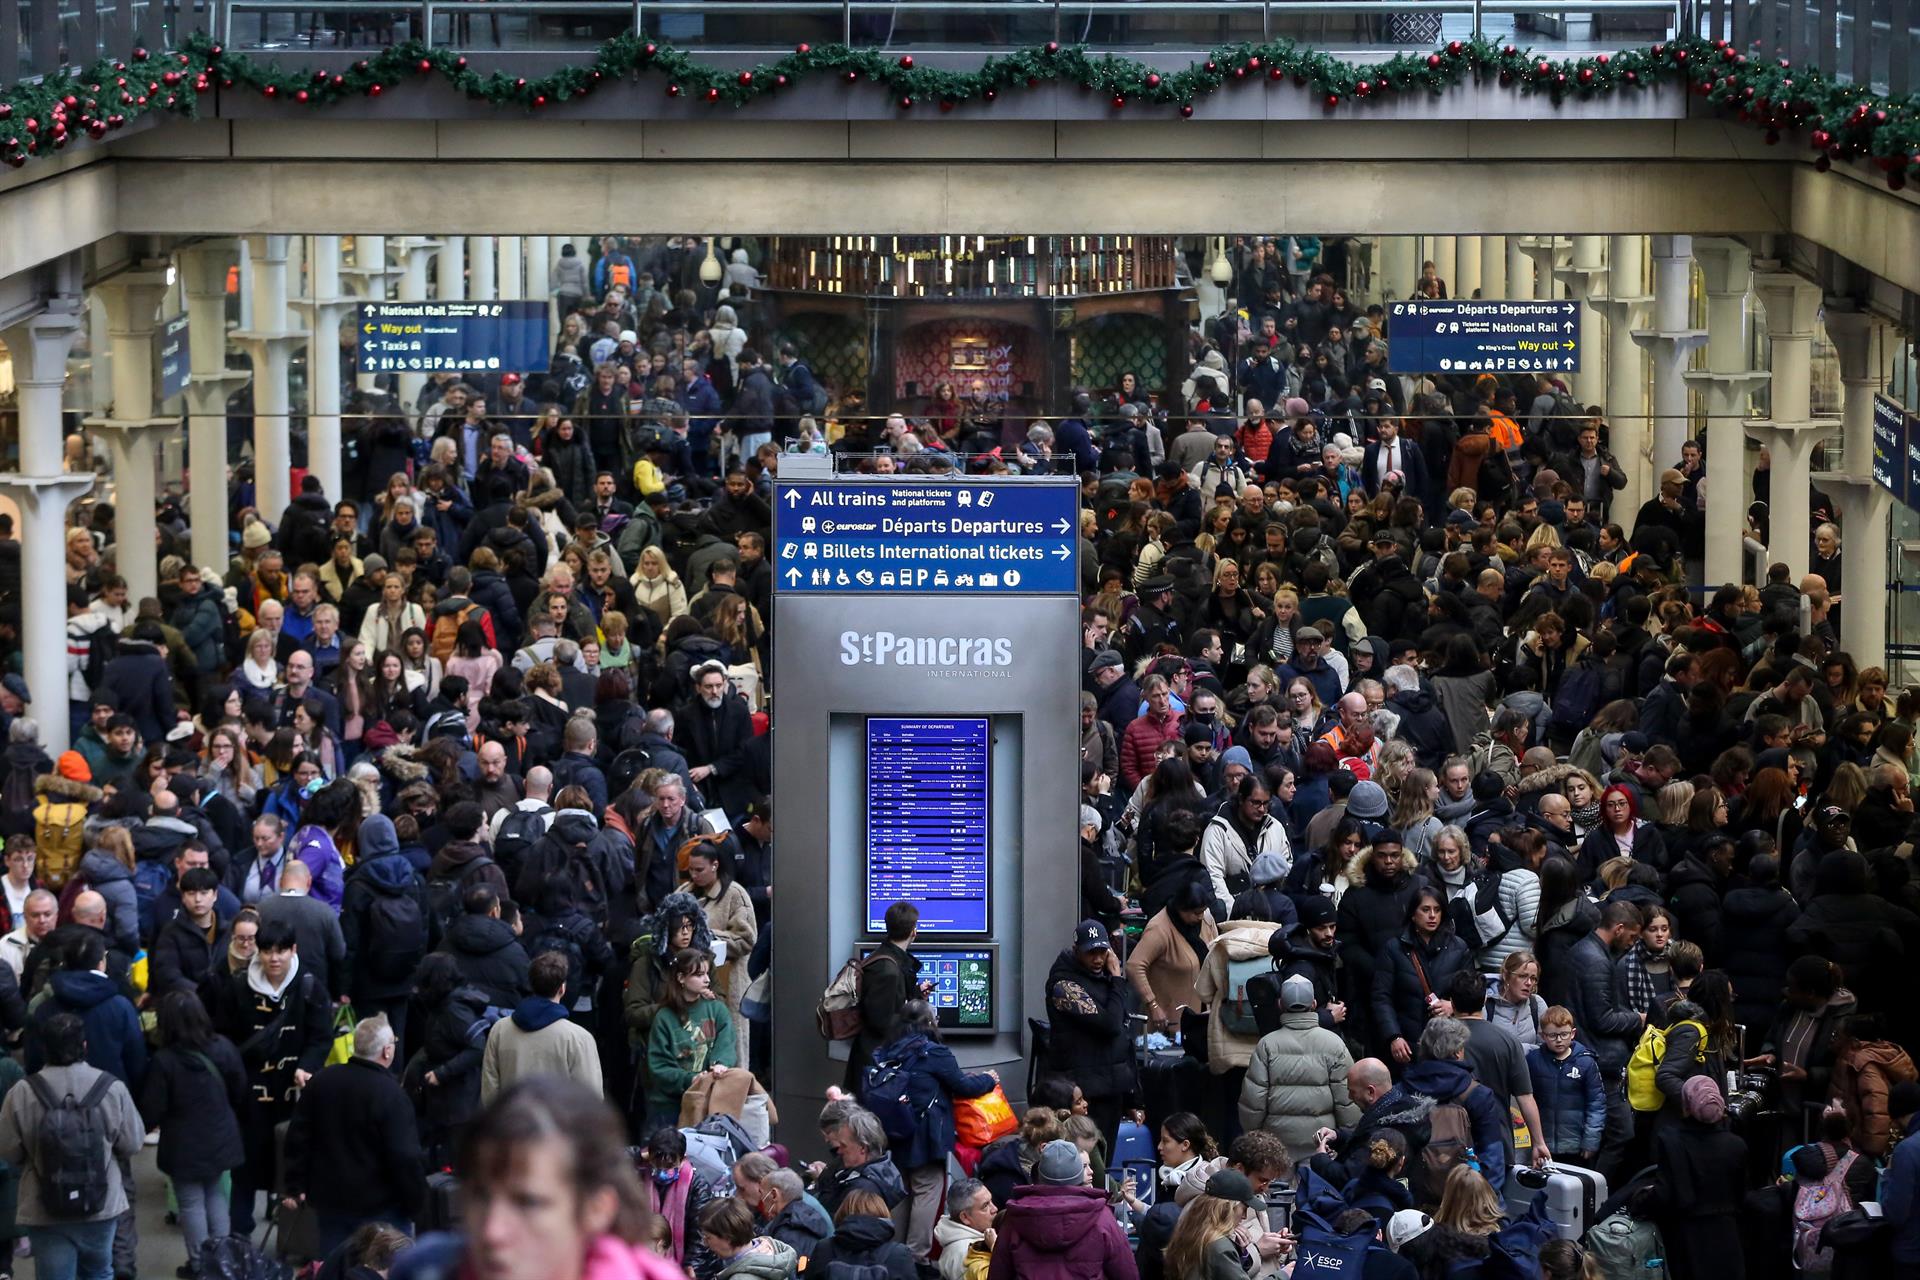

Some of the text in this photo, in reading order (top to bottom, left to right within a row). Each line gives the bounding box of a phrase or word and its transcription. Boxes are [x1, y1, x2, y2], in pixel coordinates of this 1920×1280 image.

[379, 305, 446, 317] National Rail
[1457, 303, 1498, 317] Départs
[1501, 304, 1558, 316] Departures
[380, 324, 422, 336] Way out
[1493, 322, 1558, 333] National Rail
[381, 341, 409, 351] Taxis
[1518, 340, 1558, 352] Way out
[811, 491, 886, 507] All trains
[892, 489, 952, 498] National tickets
[892, 498, 946, 508] and platforms
[836, 516, 1044, 537] eurostar Départs Departures
[822, 543, 1044, 560] Billets International tickets
[927, 670, 1013, 678] INTERNATIONAL
[1318, 1256, 1343, 1267] ESCP
